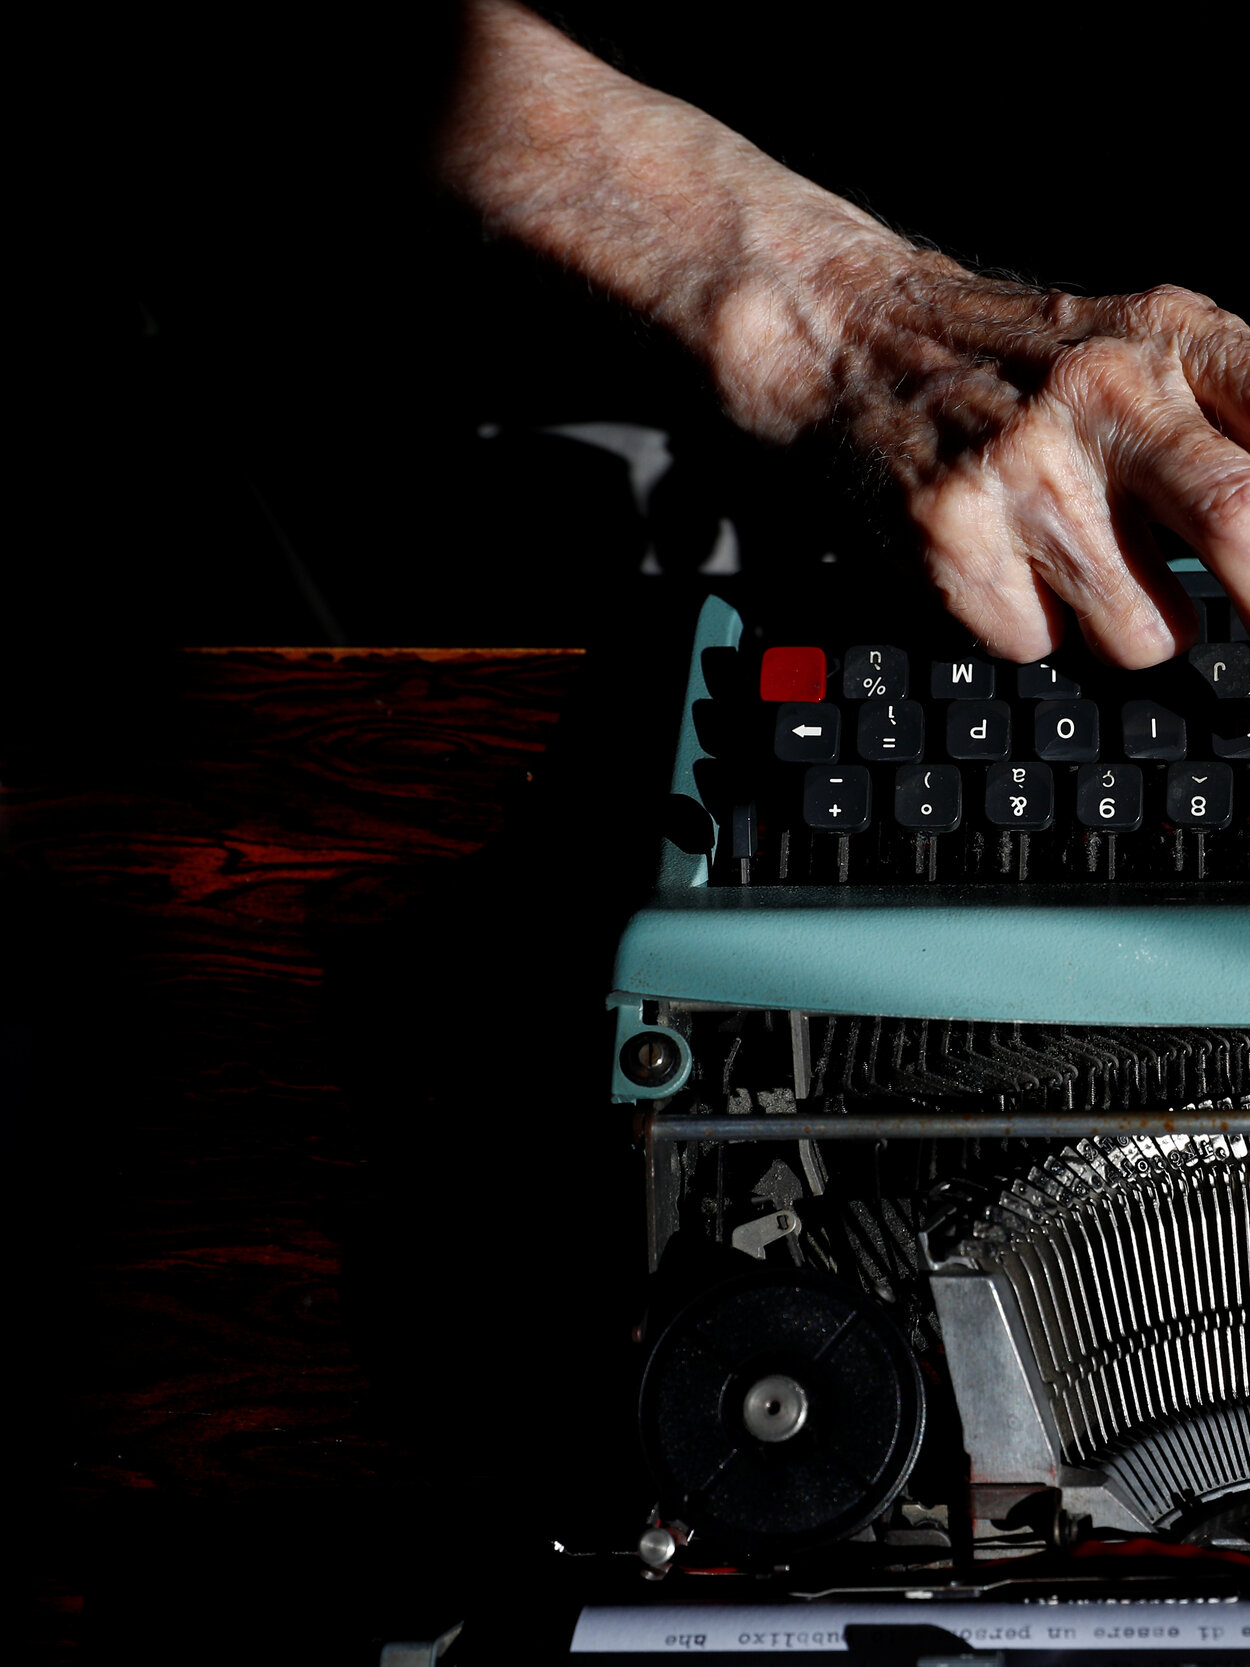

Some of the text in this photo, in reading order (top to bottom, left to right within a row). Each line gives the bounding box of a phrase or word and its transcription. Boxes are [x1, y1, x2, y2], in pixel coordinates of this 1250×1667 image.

[869, 651, 882, 672] ù
[1213, 662, 1226, 682] J
[952, 663, 973, 684] M
[862, 676, 887, 697] %
[969, 718, 987, 739] P
[1056, 717, 1075, 739] O
[1011, 767, 1026, 789] à
[828, 803, 842, 818] +
[1009, 796, 1028, 817] &
[1099, 797, 1116, 819] 9
[1190, 795, 1207, 817] 8
[1047, 1627, 1077, 1642] un
[1197, 1626, 1225, 1641] di
